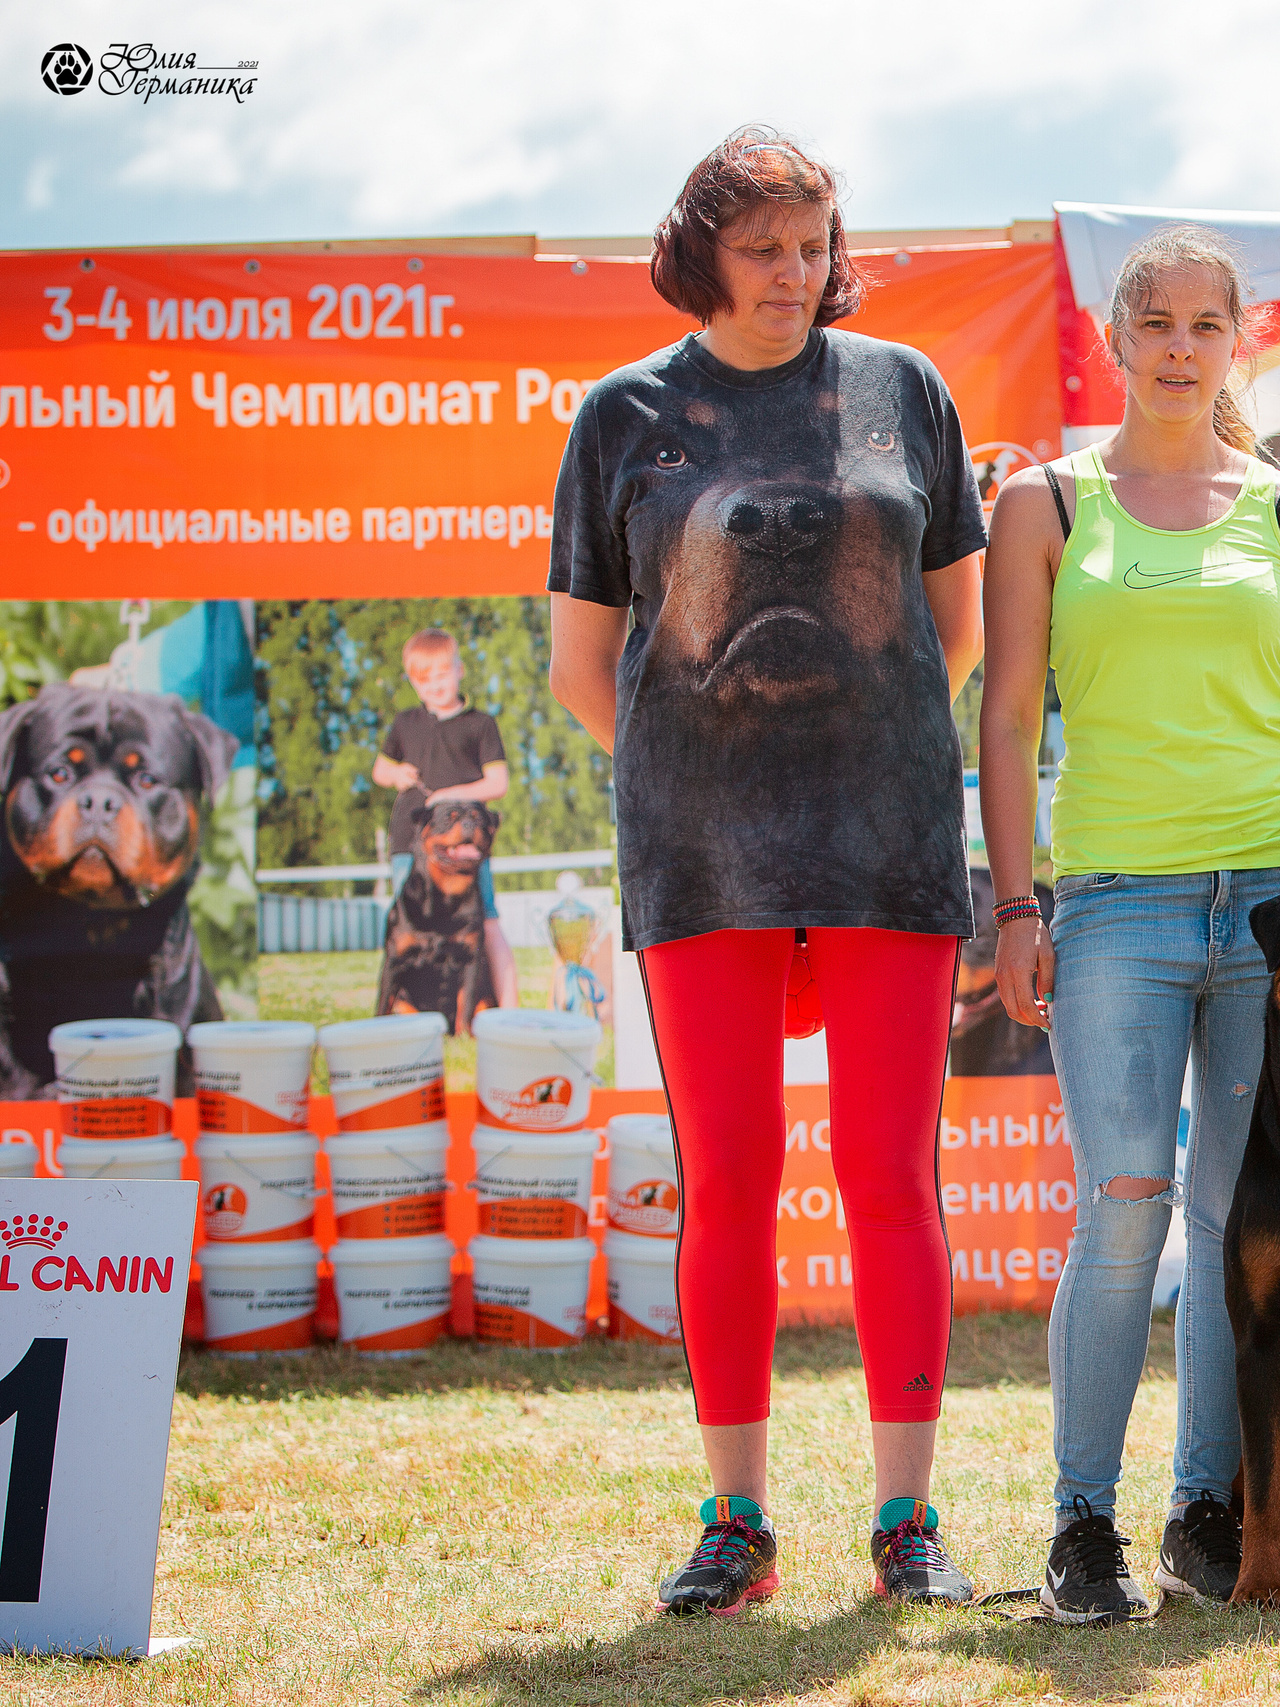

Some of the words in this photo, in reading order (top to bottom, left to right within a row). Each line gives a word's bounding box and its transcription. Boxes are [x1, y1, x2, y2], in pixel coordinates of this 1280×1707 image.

[42, 287, 132, 342] 3-4
[146, 294, 292, 341] июля
[307, 283, 464, 342] 2021г.
[0, 371, 175, 429] льный
[191, 372, 500, 428] Чемпионат
[47, 499, 350, 551] официальные
[31, 1254, 175, 1294] CANIN
[902, 1383, 934, 1392] adidas
[0, 1336, 69, 1604] 1
